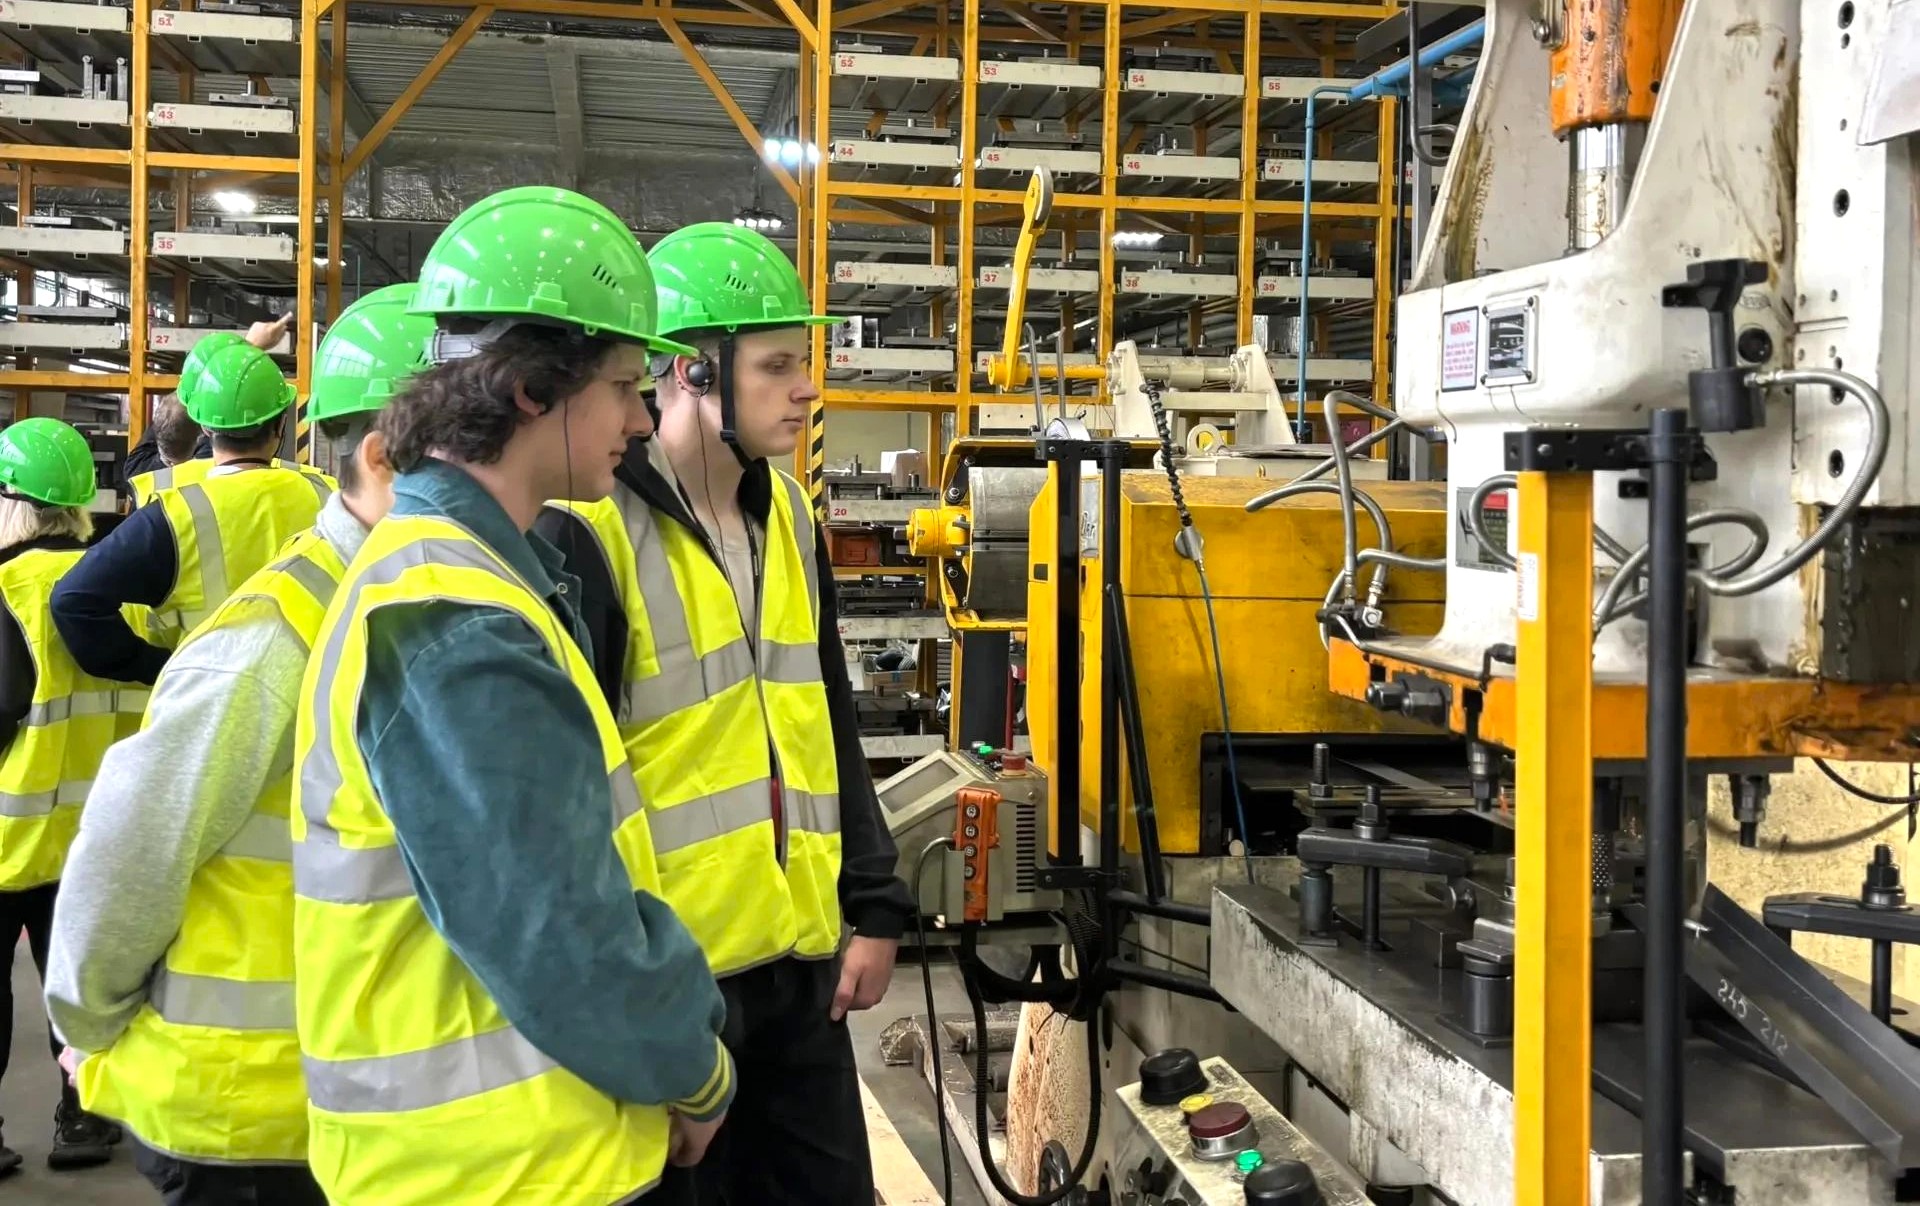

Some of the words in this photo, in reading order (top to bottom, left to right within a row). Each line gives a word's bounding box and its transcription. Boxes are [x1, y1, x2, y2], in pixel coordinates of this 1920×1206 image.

[158, 17, 173, 27] 51
[841, 58, 854, 68] 52
[983, 67, 997, 76] 53
[1132, 74, 1145, 83] 54
[1268, 82, 1281, 91] 55
[158, 110, 174, 120] 43
[840, 147, 853, 156] 44
[987, 153, 1000, 162] 45
[1127, 161, 1140, 170] 46
[1269, 165, 1282, 174] 47
[158, 240, 174, 250] 35
[839, 269, 853, 278] 36
[984, 274, 998, 283] 37
[1126, 279, 1138, 288] 38
[1263, 282, 1275, 292] 39
[155, 335, 170, 344] 27
[836, 354, 849, 363] 28
[834, 508, 847, 516] 20
[1760, 1017, 1789, 1057] 212
